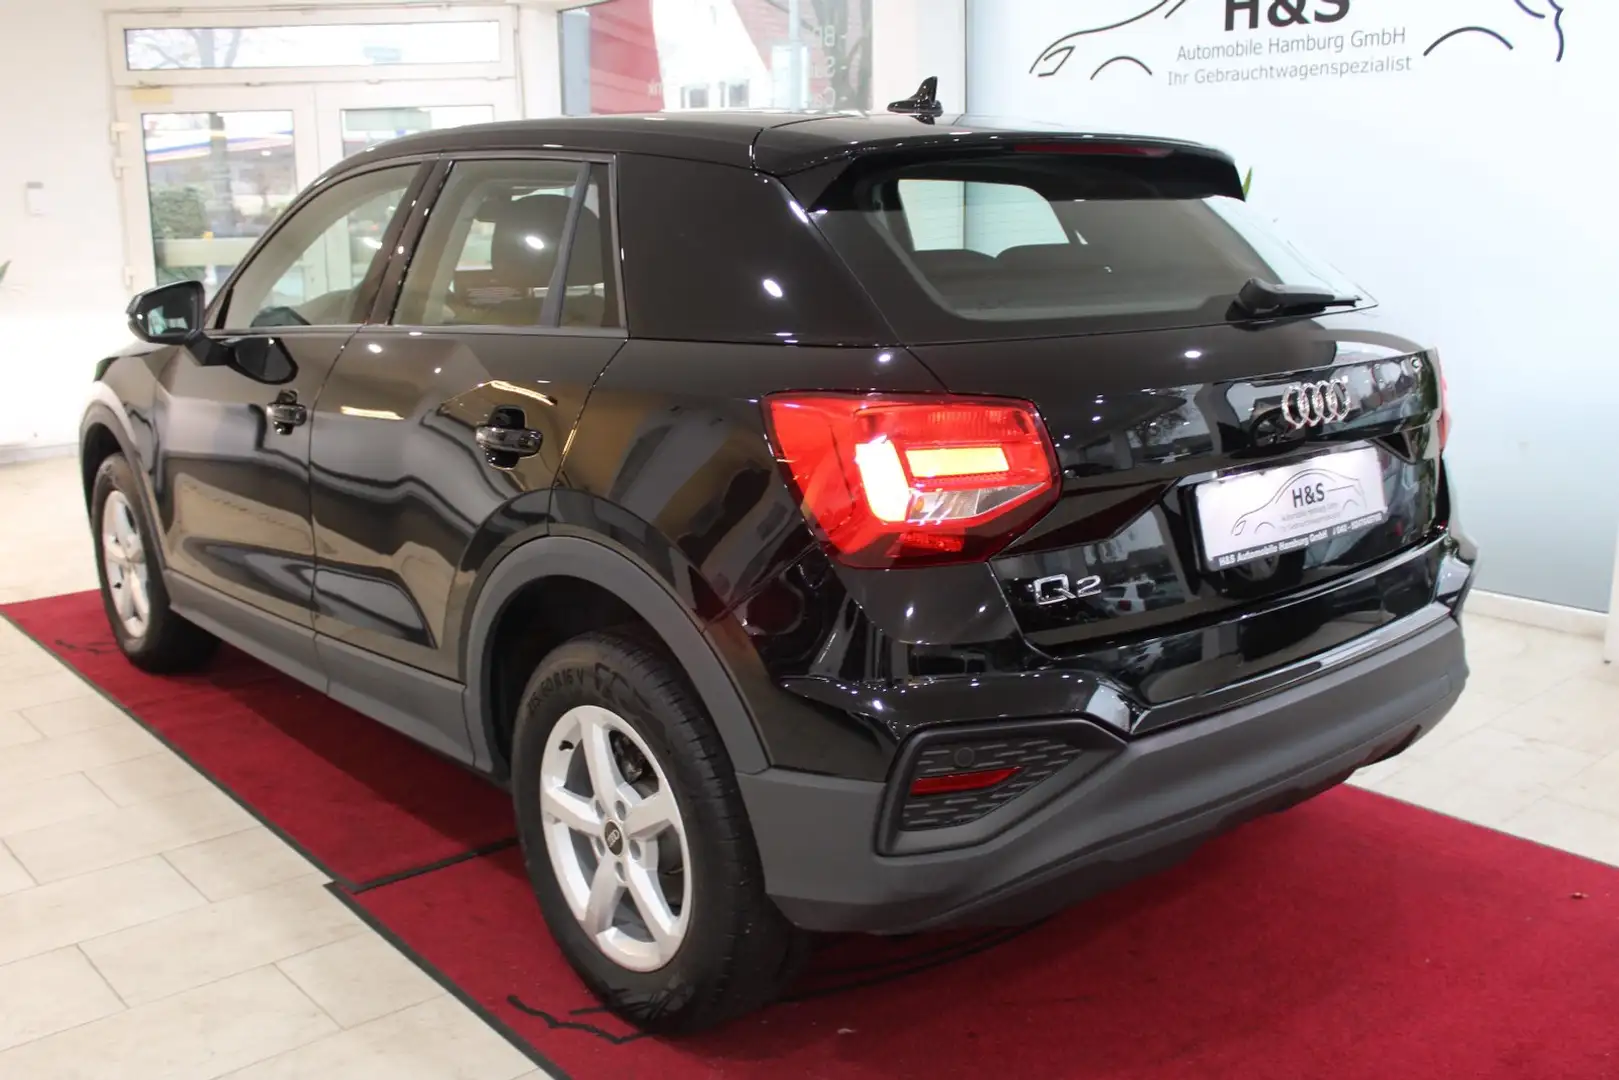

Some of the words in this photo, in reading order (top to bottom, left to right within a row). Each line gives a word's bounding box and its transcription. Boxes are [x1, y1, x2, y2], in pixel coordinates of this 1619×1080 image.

[1177, 39, 1263, 62] Automobile
[1269, 34, 1344, 53] Hamburg
[1351, 27, 1406, 48] GmbH
[1168, 70, 1190, 86] Ihr
[1194, 56, 1412, 84] Gebrauchtwagenspezialist
[1292, 482, 1325, 508] H&S
[1219, 554, 1236, 567] H&S
[1237, 544, 1278, 562] Automobile
[1279, 536, 1309, 551] Hamburg
[1309, 529, 1328, 543] GmbH
[1034, 574, 1102, 605] Q2
